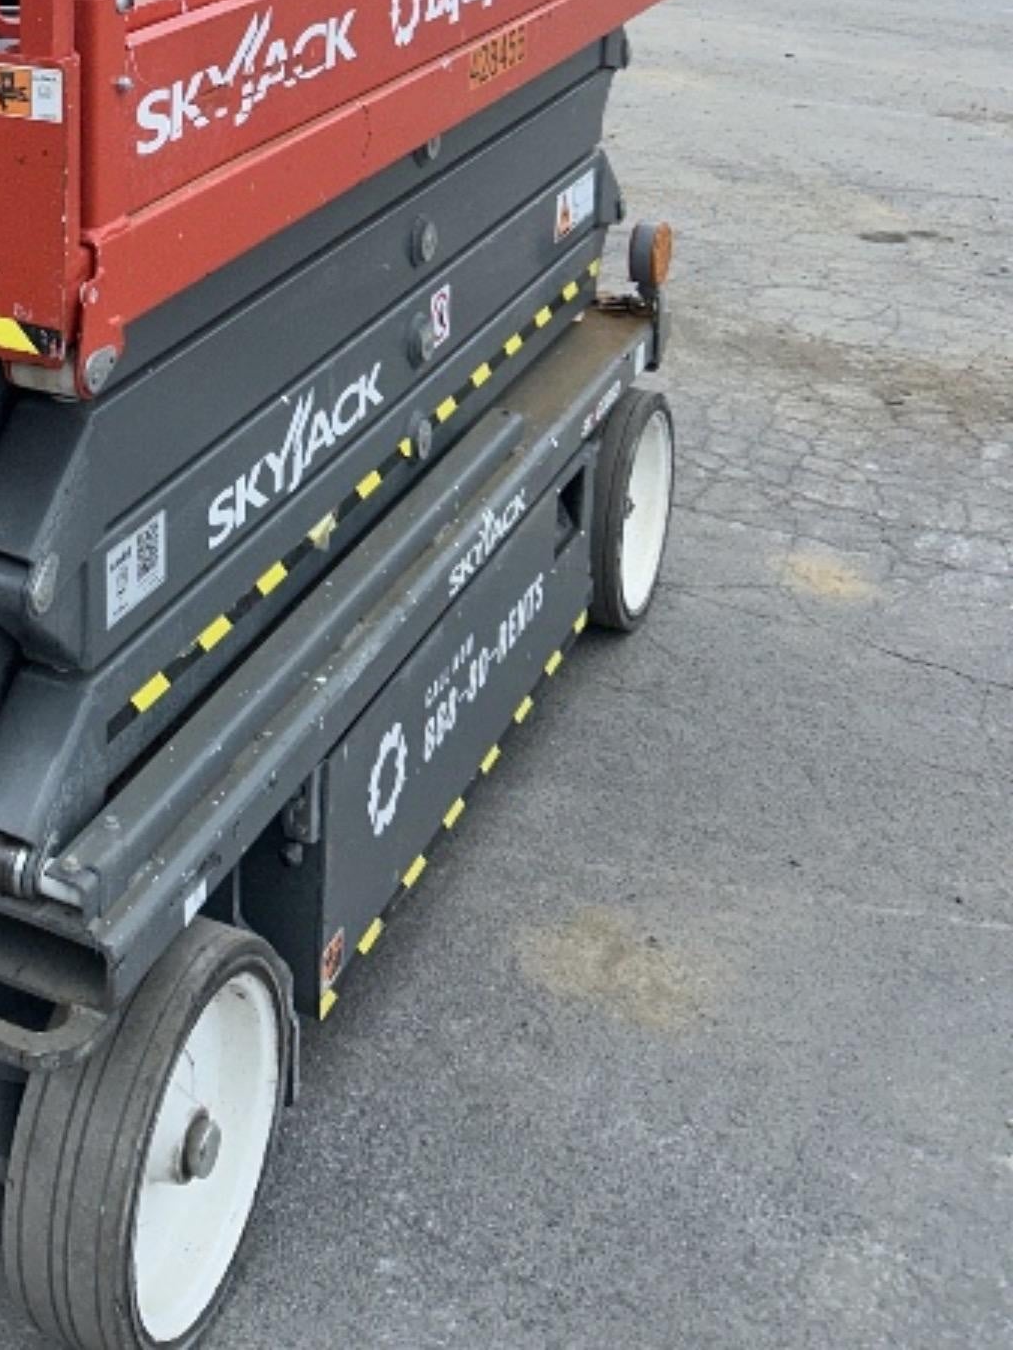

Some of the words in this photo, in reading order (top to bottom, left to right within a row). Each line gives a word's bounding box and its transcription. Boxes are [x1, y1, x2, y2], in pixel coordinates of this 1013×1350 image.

[136, 5, 358, 155] SKYJACK
[207, 361, 385, 550] SKYJACK
[448, 487, 526, 598] SKYJACK
